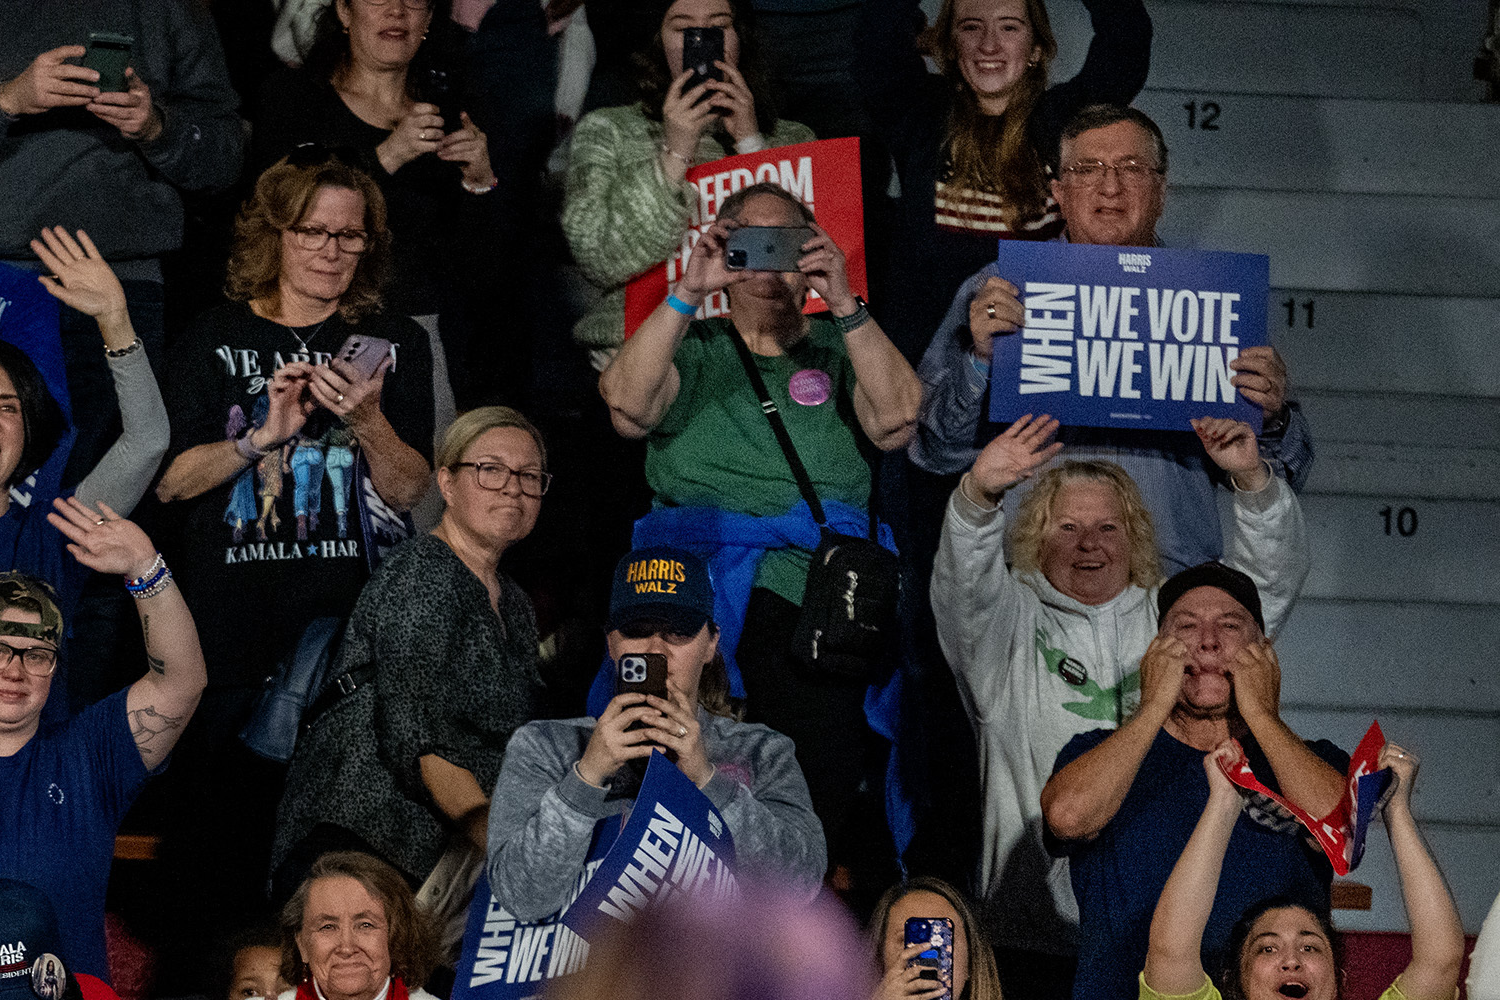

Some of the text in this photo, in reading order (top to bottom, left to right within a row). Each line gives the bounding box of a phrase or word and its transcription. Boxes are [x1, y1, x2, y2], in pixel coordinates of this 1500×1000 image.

[1183, 101, 1221, 132] 12
[1118, 252, 1152, 267] HARRIS
[1122, 265, 1148, 274] WALZ
[1079, 284, 1241, 345] WE VOTE
[1282, 298, 1315, 330] 11
[1019, 281, 1077, 394] WHEN
[1076, 339, 1239, 404] WE WIN
[1378, 505, 1418, 537] 10
[225, 539, 361, 564] KAMALA HAR
[626, 558, 686, 583] HARRIS
[635, 580, 677, 594] WALZ
[598, 801, 685, 926] WHEN
[469, 893, 517, 989] WHE
[506, 924, 556, 984] WE
